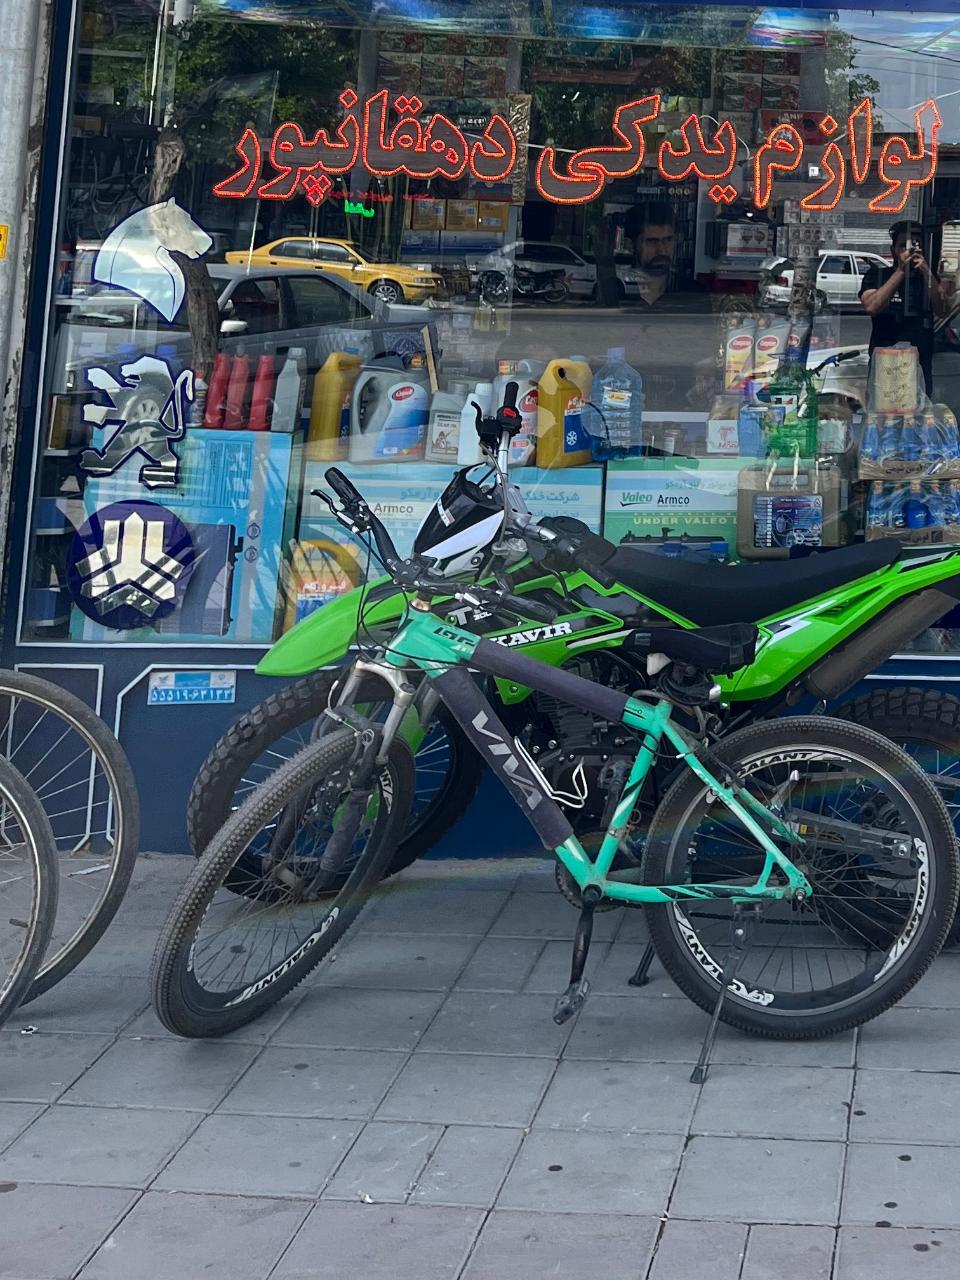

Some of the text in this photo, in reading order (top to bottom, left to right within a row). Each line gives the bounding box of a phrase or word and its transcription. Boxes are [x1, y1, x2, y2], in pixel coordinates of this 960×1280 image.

[212, 89, 943, 212] لوازم یدکی دهقانپور
[621, 491, 690, 505] Valeo Armco
[373, 503, 414, 514] Armco
[633, 516, 728, 525] UNDER VALEO
[488, 621, 573, 648] KAVIR
[471, 710, 543, 811] VIVA
